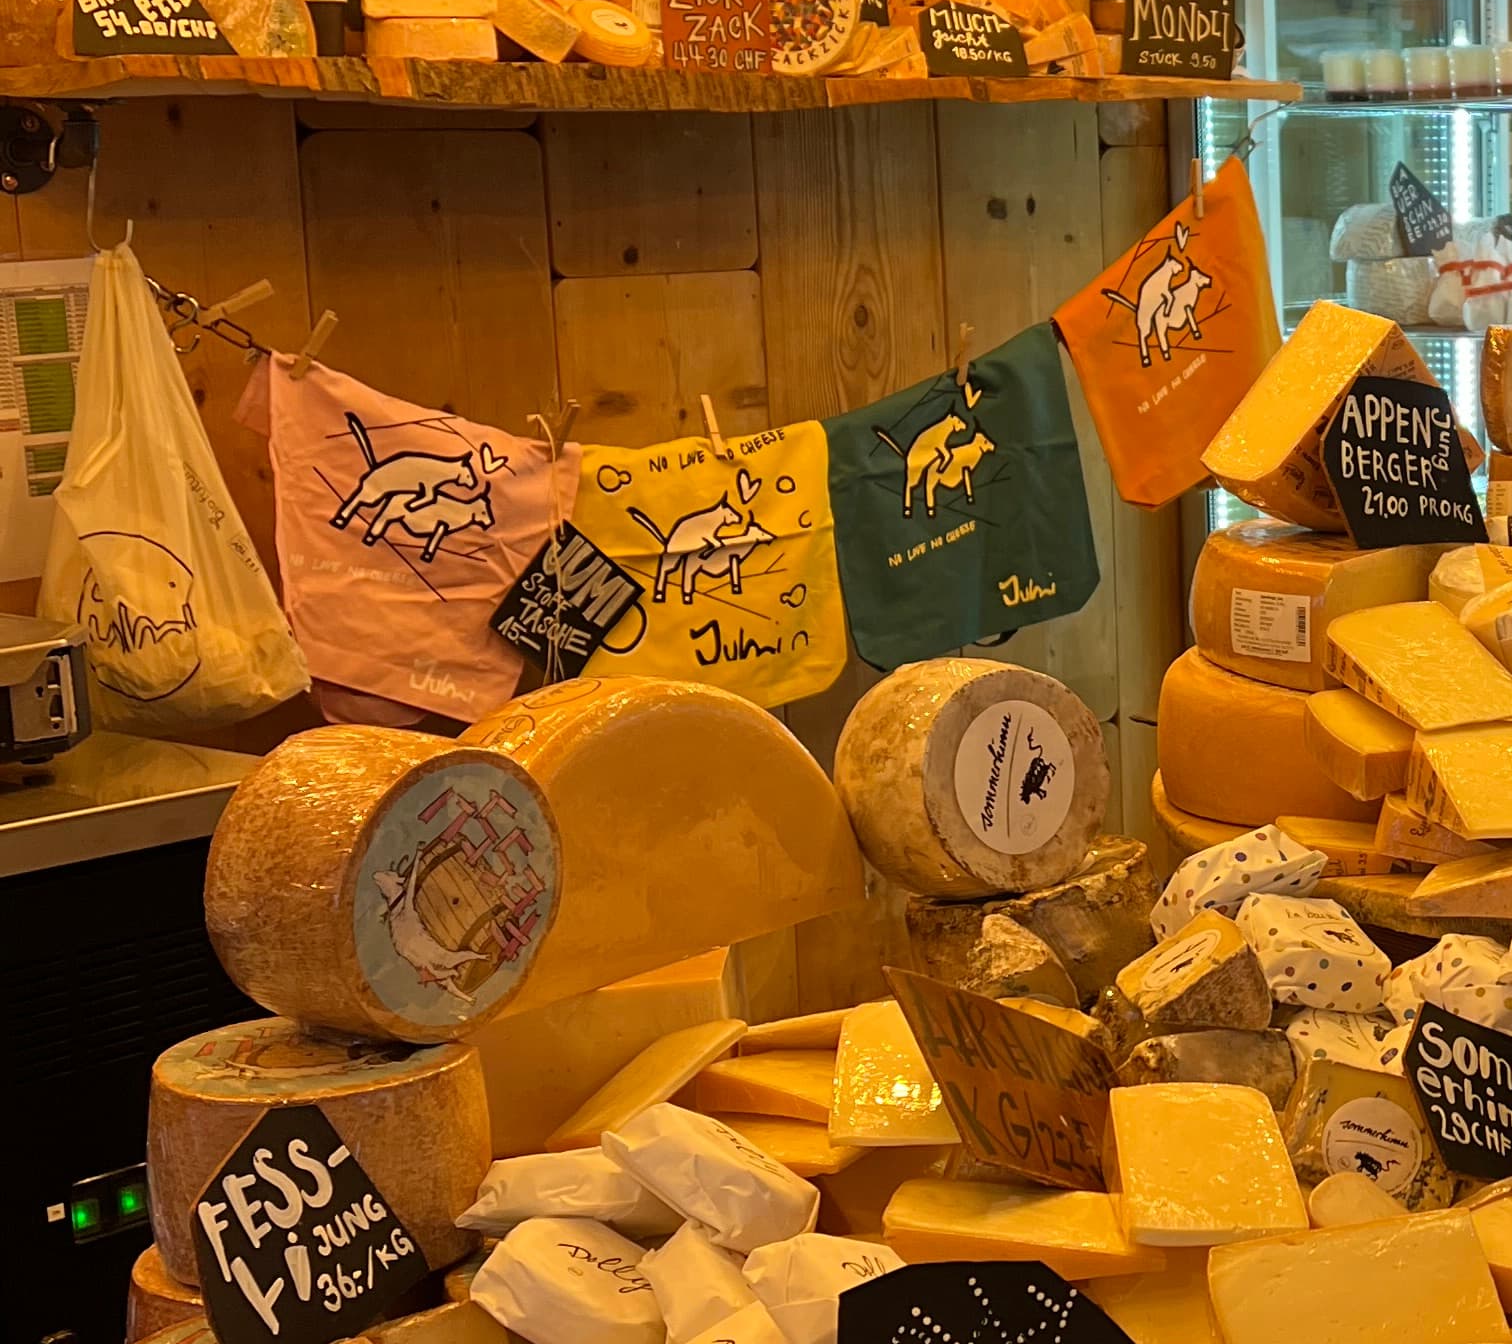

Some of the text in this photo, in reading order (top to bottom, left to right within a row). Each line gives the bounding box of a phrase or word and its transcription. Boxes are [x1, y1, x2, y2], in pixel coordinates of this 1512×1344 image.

[684, 2, 765, 43] ZACK
[734, 49, 768, 71] CHF
[1341, 393, 1432, 449] APPEN
[649, 456, 669, 473] NO
[679, 449, 706, 470] LOVE
[738, 427, 786, 456] CHEESE
[1341, 439, 1438, 491] BERGER
[1361, 485, 1409, 519] 21.00
[542, 533, 636, 628] JUMI
[519, 596, 592, 657] TASCHE
[312, 1193, 387, 1257] JUNG
[558, 1241, 654, 1295] Dolly
